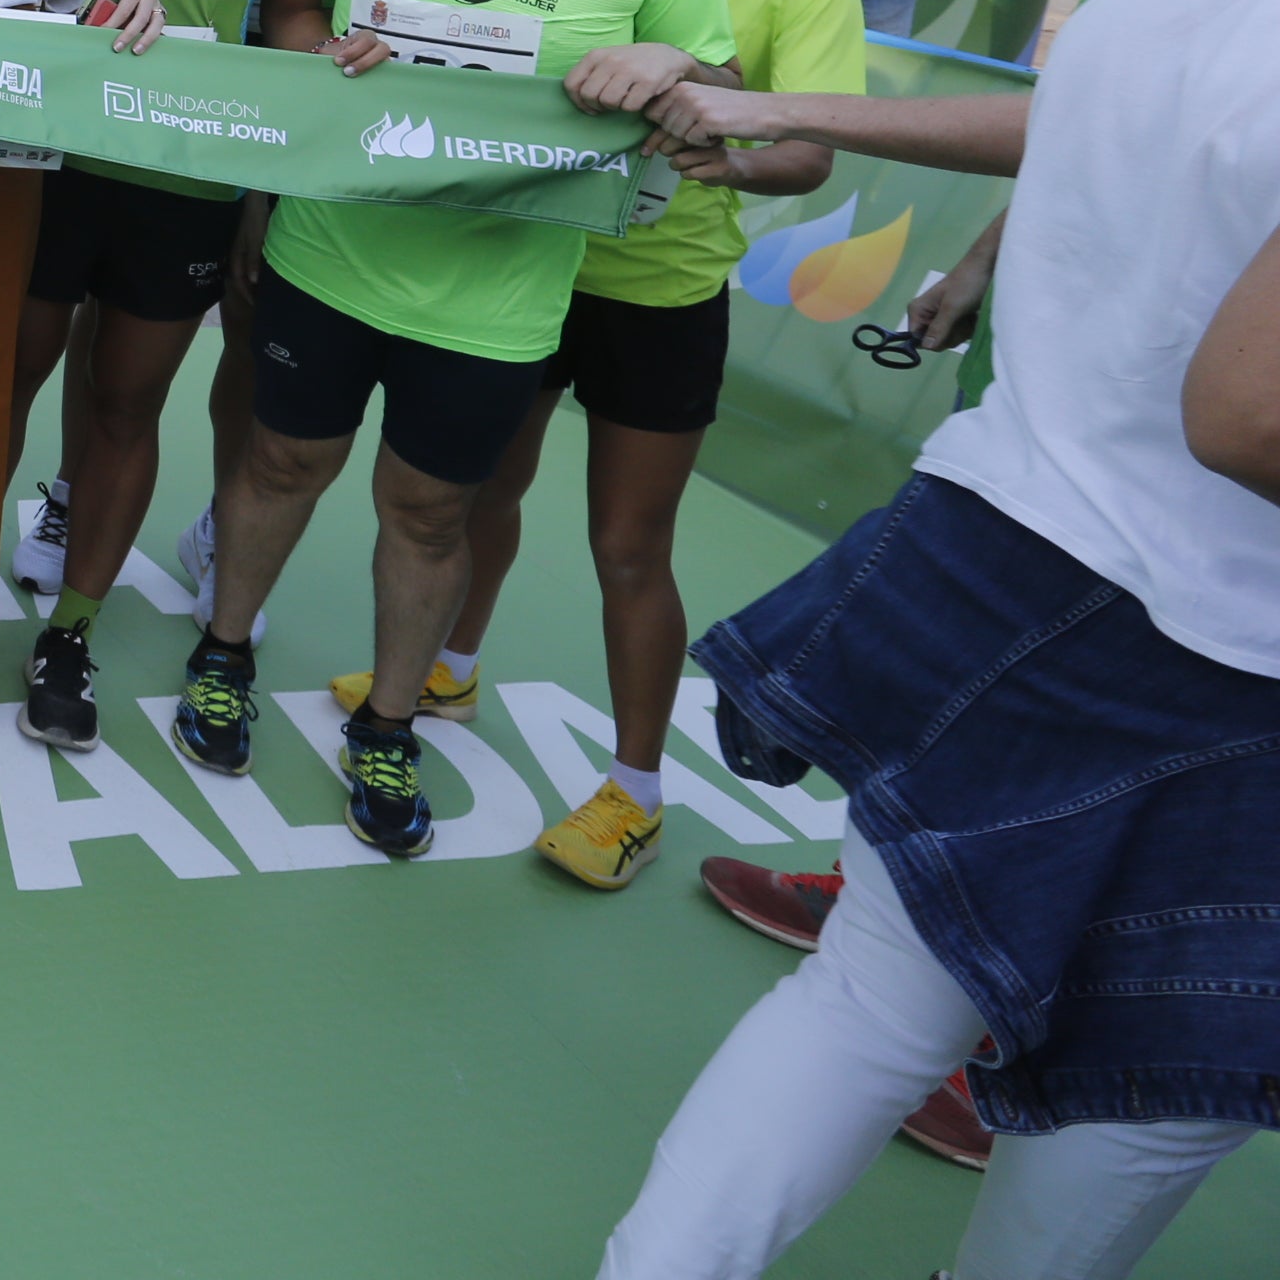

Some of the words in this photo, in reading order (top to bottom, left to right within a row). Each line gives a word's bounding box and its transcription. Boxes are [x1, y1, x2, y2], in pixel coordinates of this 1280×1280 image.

[10, 94, 43, 109] DEPORTE
[148, 90, 260, 120] FUNDACIÓN
[150, 110, 223, 136] DEPORTE
[227, 123, 287, 146] JOVEN
[444, 135, 629, 178] IBERDROLA
